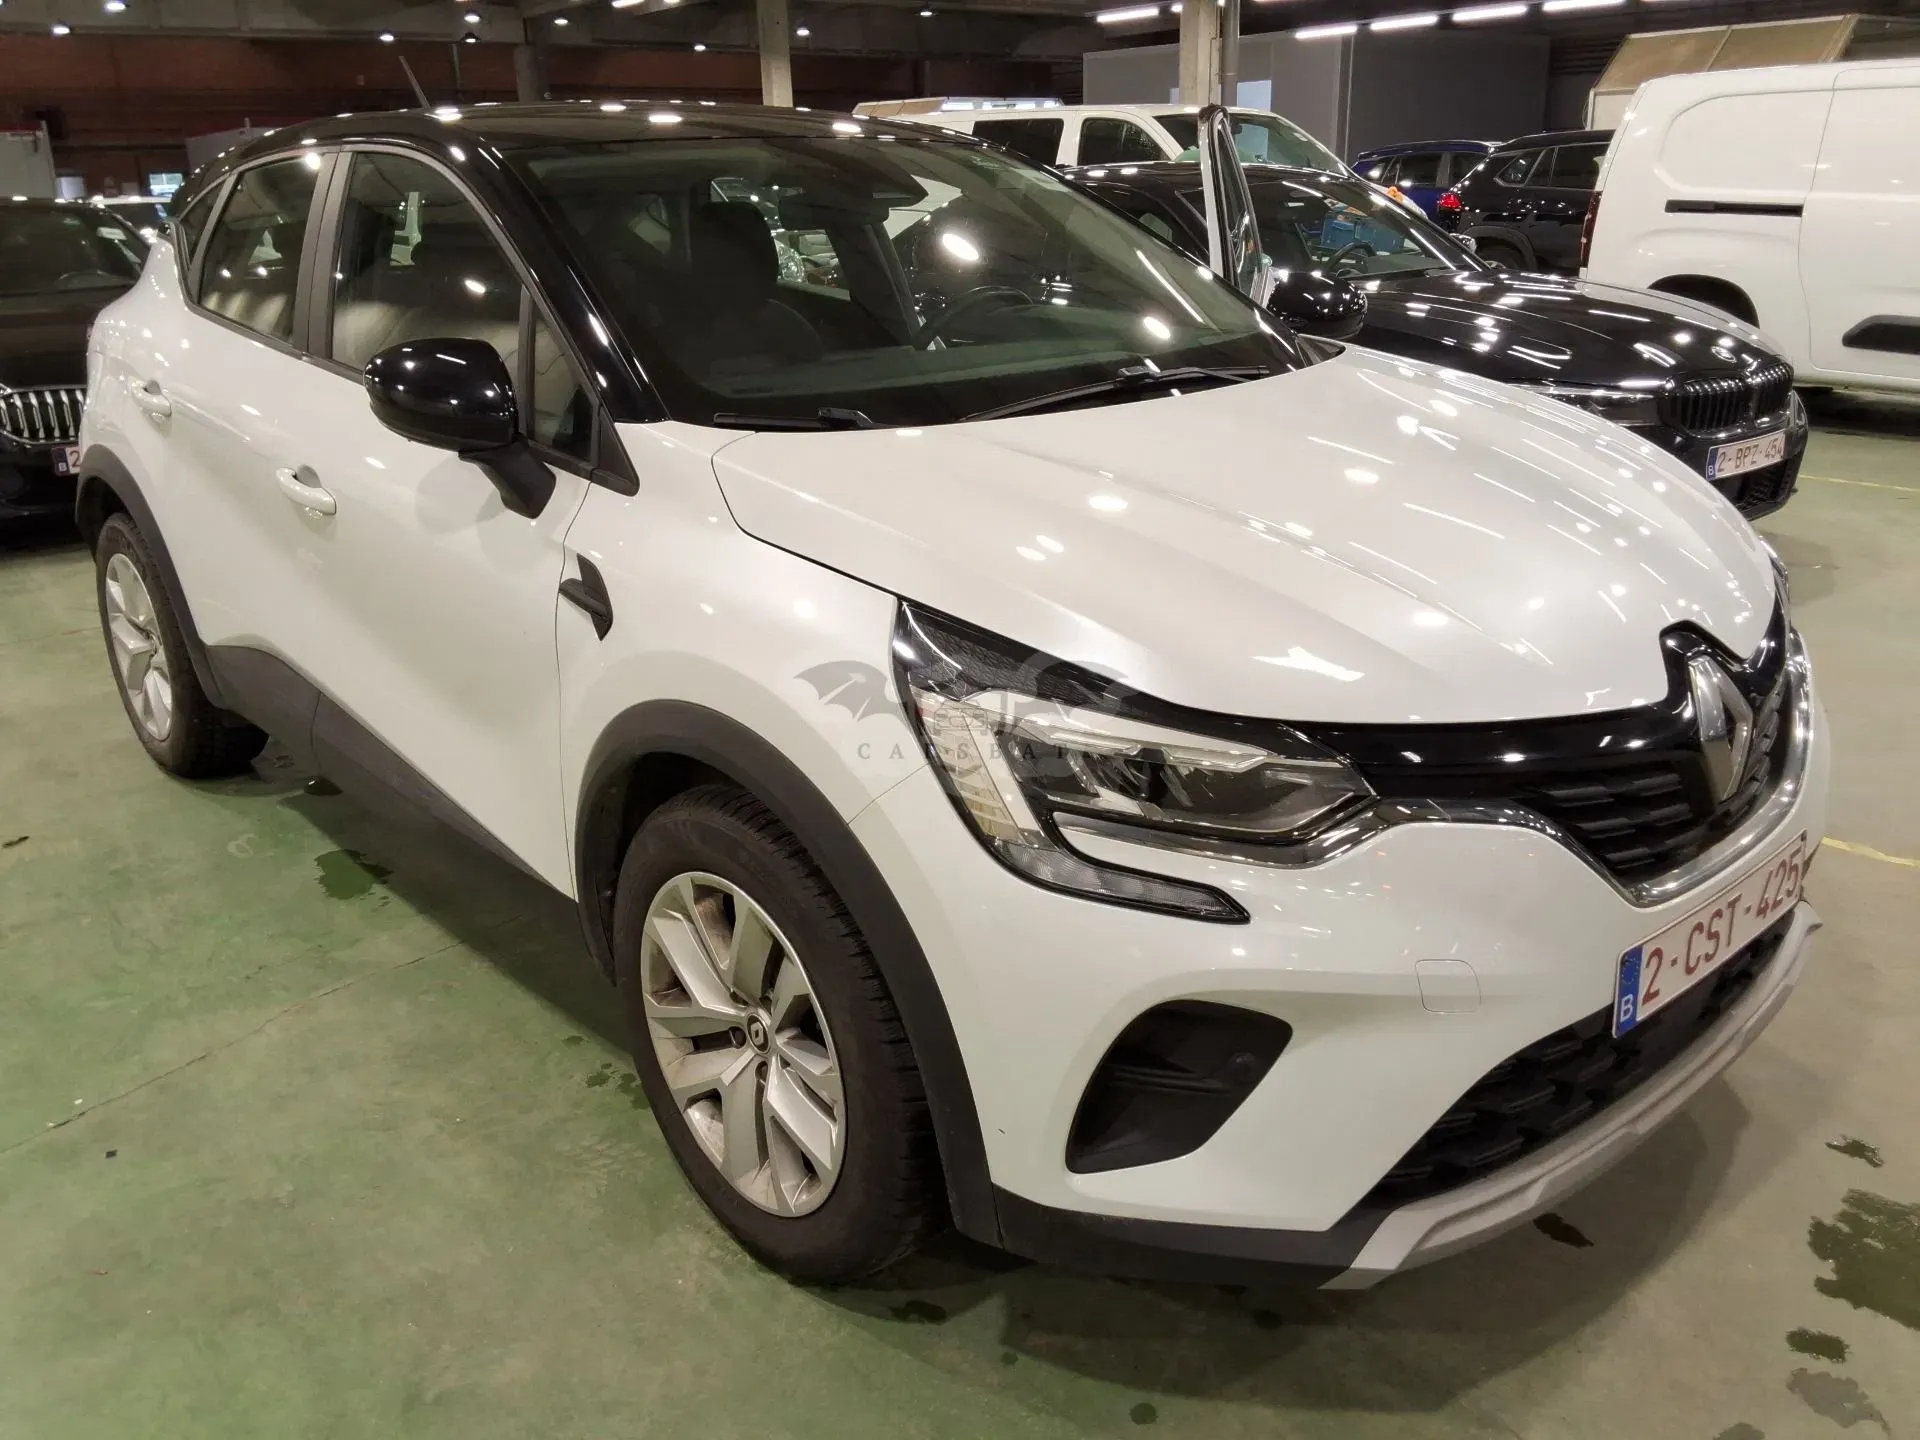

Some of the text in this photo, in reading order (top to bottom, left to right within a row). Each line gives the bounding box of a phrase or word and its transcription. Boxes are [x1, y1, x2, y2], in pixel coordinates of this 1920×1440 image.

[1708, 465, 1713, 476] B
[1641, 846, 1802, 1006] 2-CST-425
[1619, 994, 1633, 1023] B
